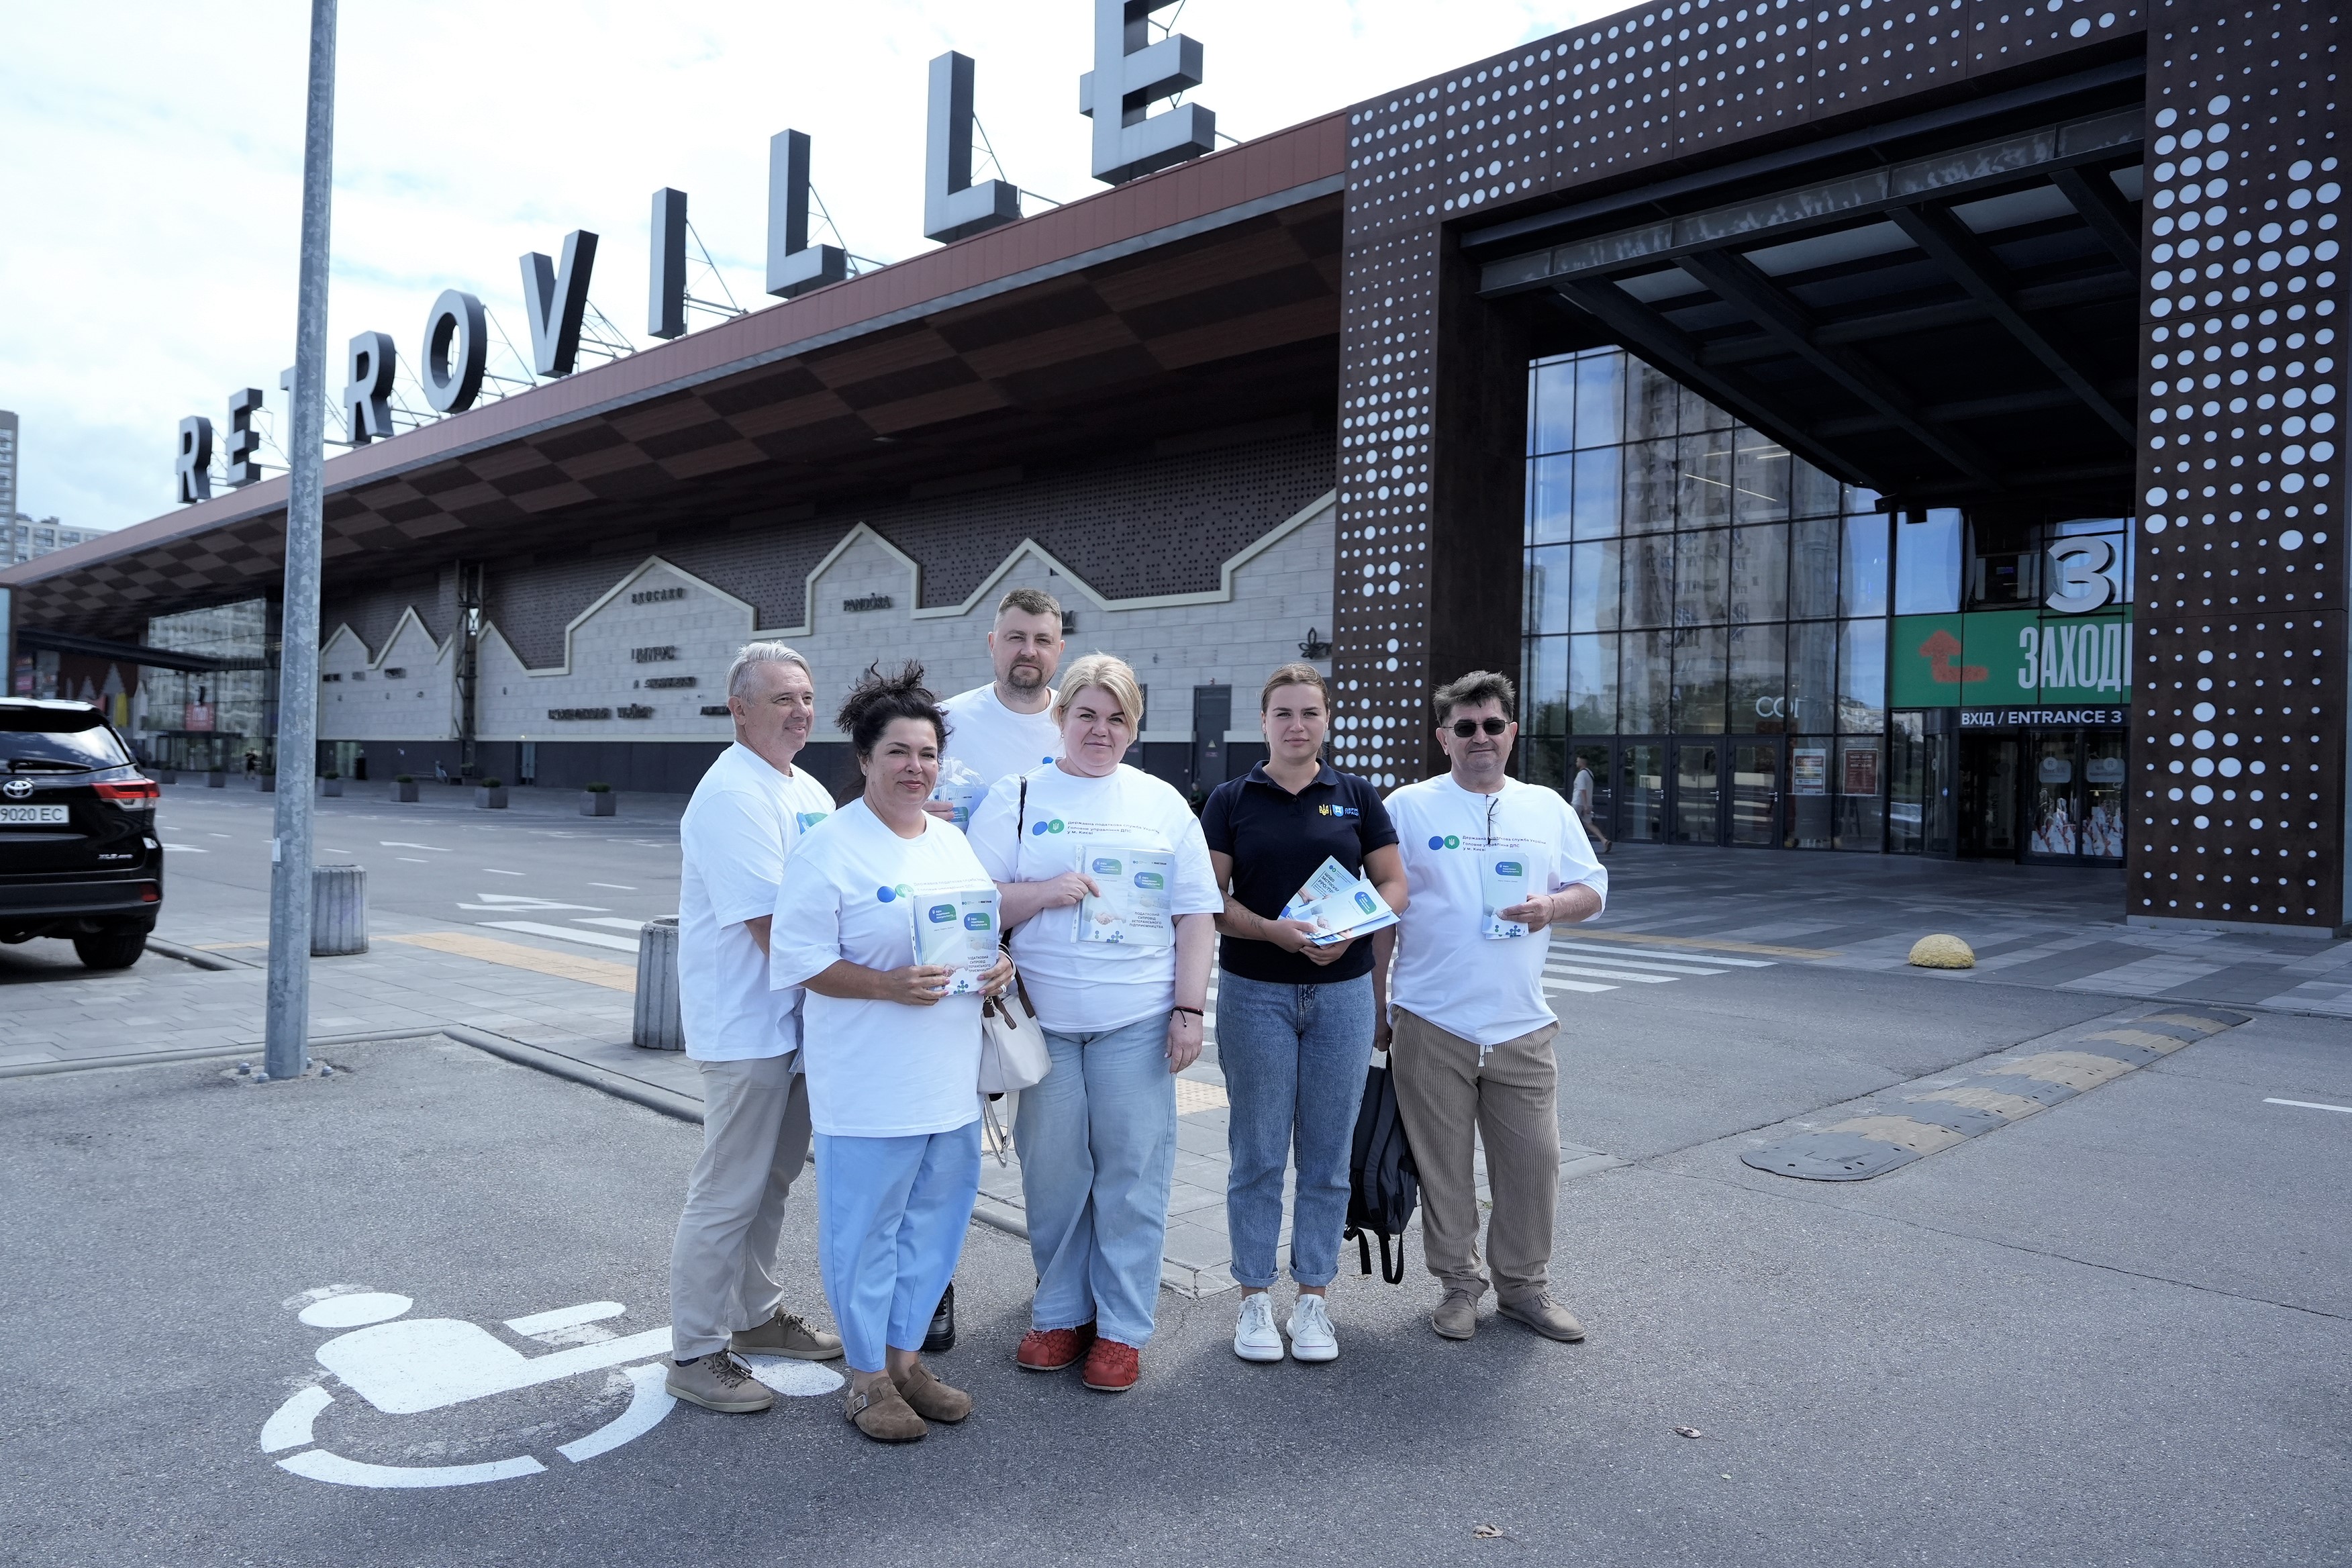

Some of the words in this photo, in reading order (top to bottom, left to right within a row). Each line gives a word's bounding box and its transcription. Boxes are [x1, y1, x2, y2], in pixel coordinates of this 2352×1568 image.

[2046, 536, 2115, 614] 3
[844, 593, 892, 612] PANDORA
[1961, 712, 1994, 726] ВХІД
[2008, 710, 2106, 724] ENTRANCE
[2111, 710, 2122, 724] 3
[0, 808, 36, 821] 9020
[41, 808, 62, 821] EC
[1318, 879, 1334, 893] РРО/ПР
